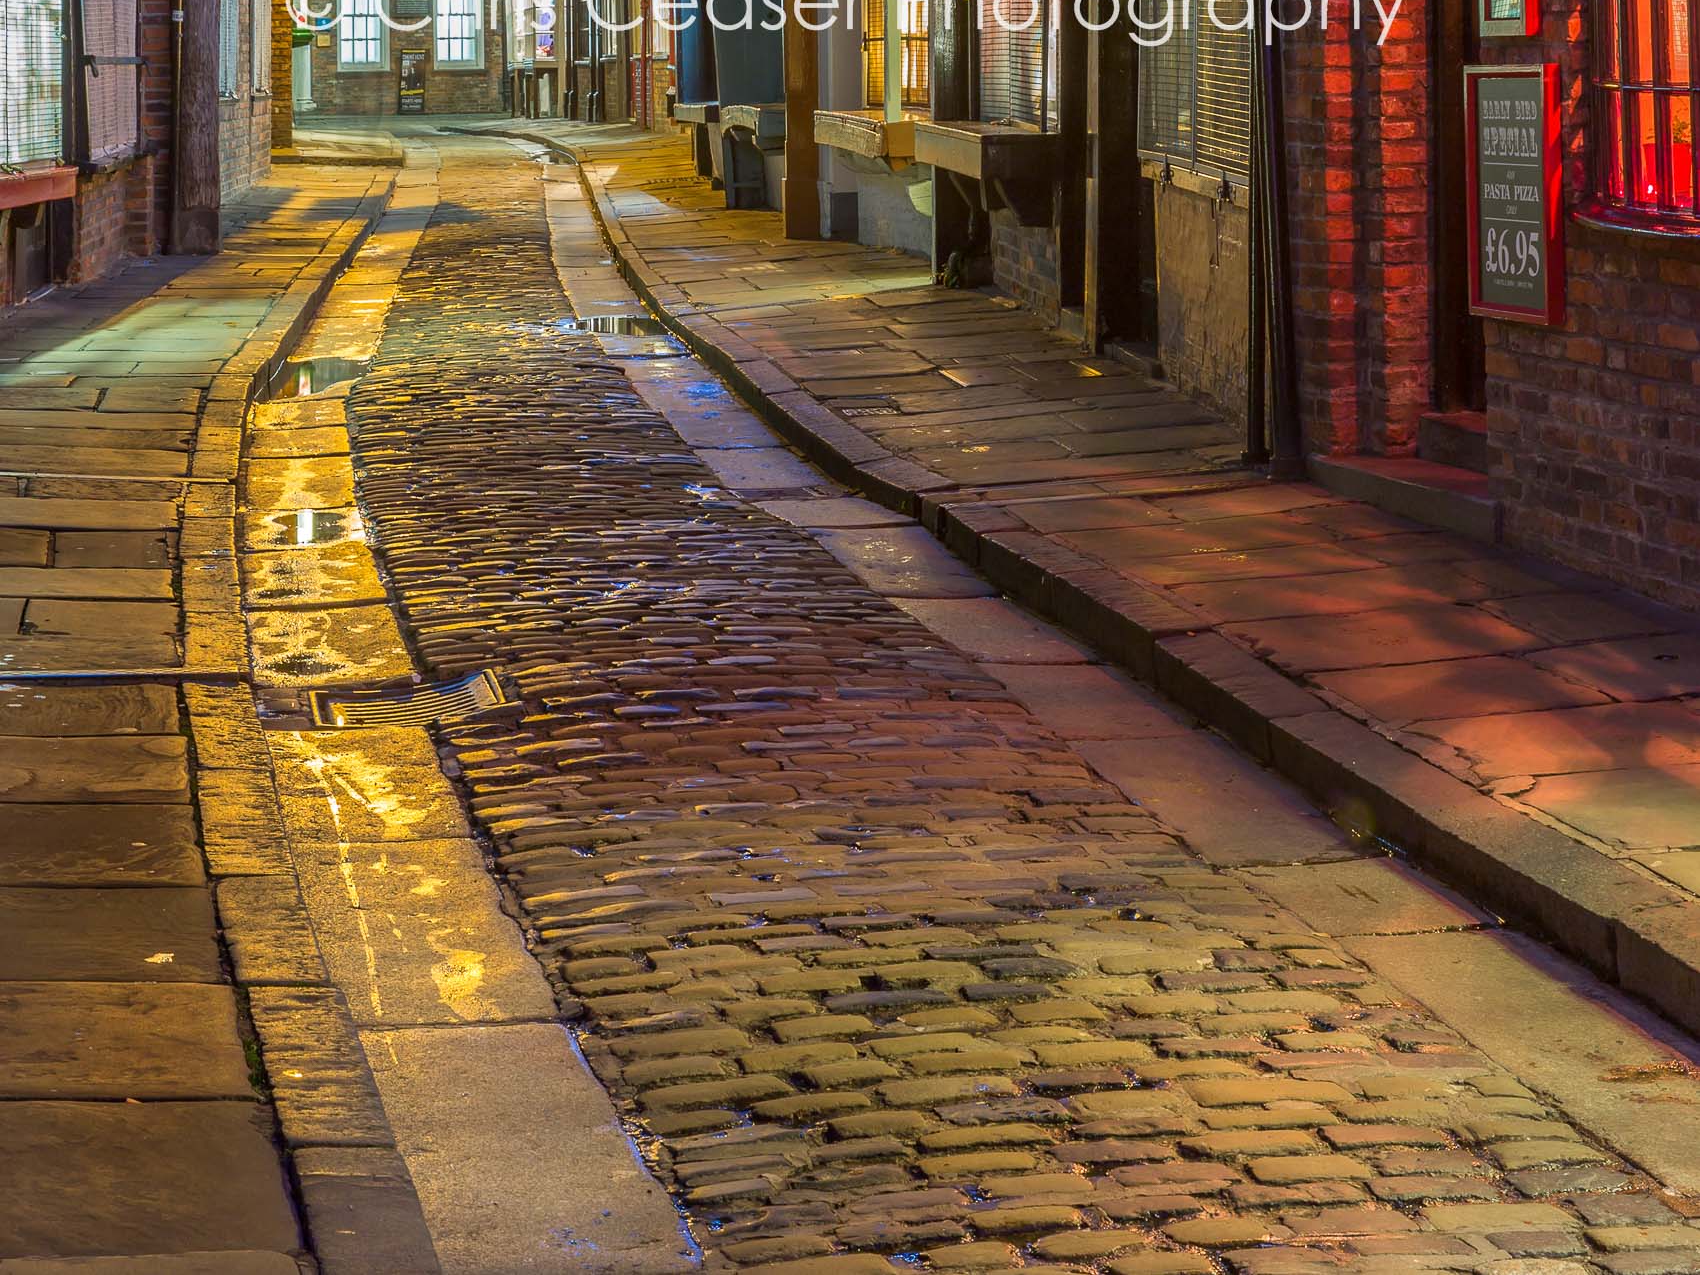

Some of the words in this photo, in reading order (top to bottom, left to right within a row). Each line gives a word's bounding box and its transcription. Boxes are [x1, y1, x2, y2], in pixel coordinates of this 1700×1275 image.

[1483, 100, 1511, 120] EARLY
[1514, 100, 1538, 121] BIRD
[1483, 126, 1538, 158] SPECIAL
[1484, 183, 1511, 200] PASTA
[1514, 185, 1540, 203] PIZZA
[1485, 227, 1540, 277] £6.95
